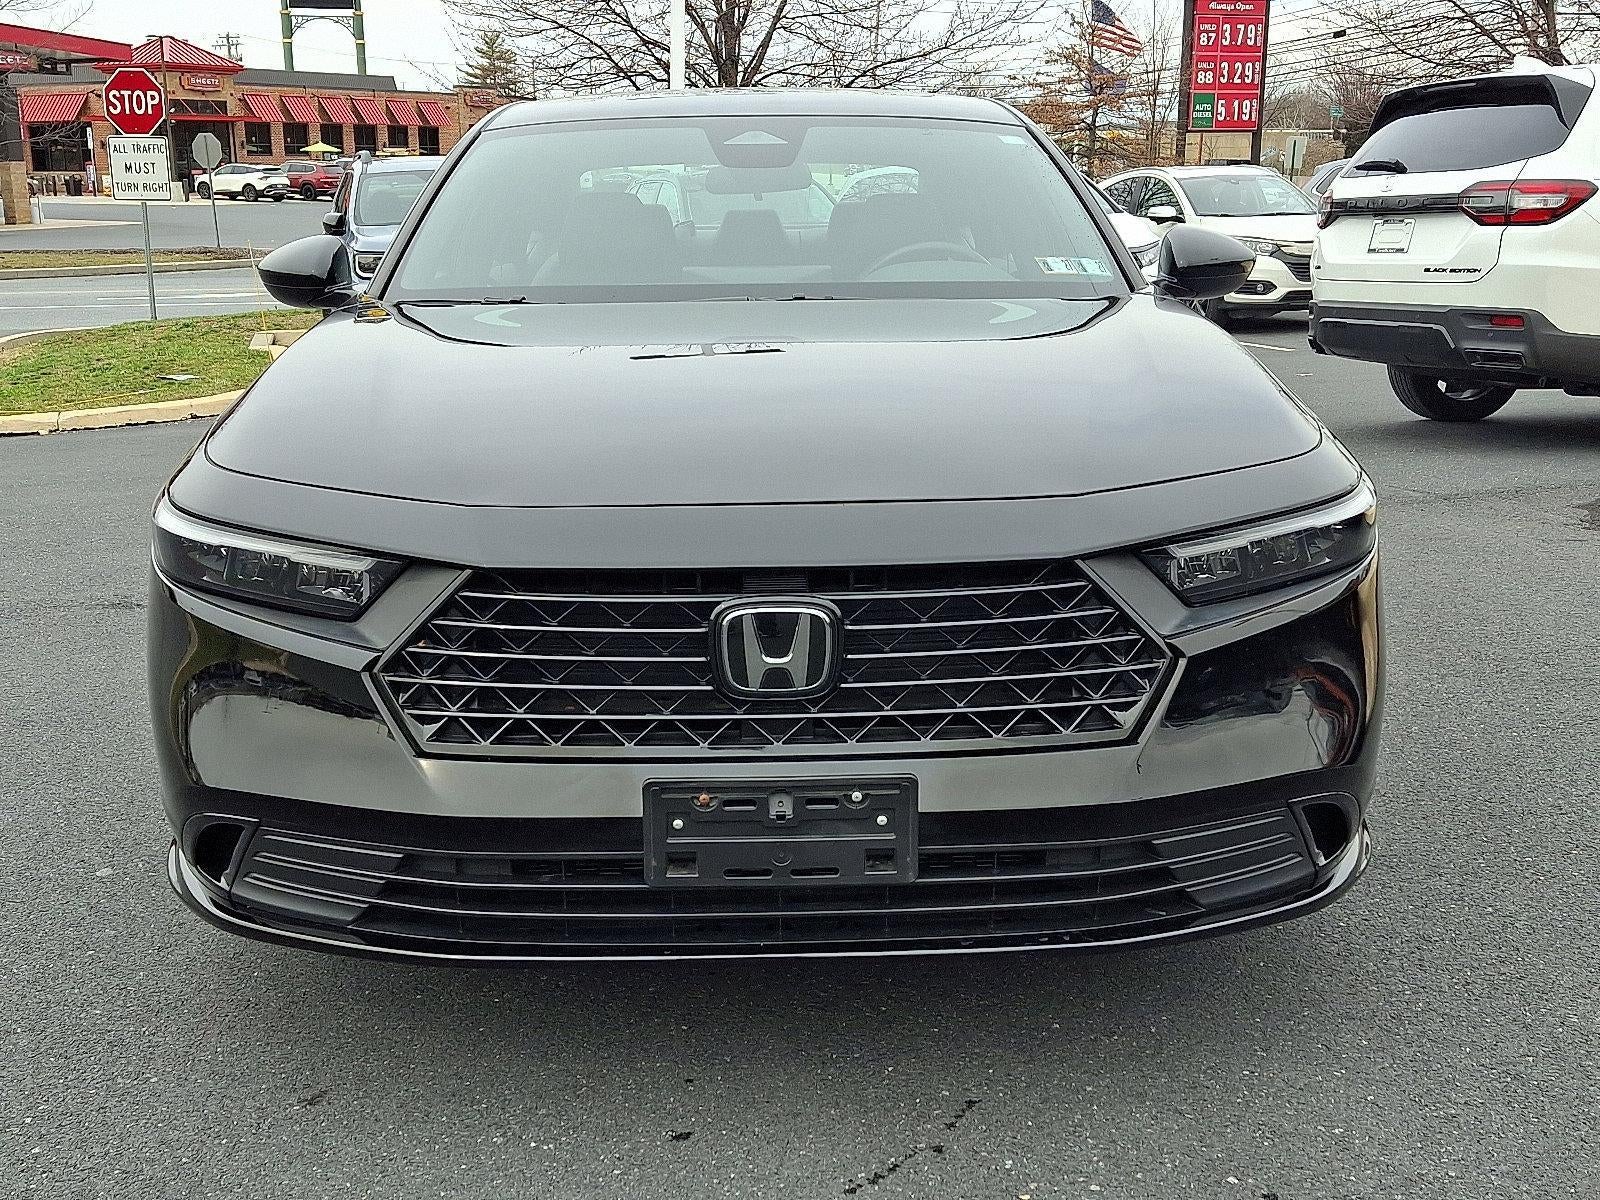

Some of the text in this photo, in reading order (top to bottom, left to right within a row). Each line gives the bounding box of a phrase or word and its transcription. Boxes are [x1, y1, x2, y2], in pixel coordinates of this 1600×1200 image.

[1208, 1, 1254, 11] Always Open
[1200, 23, 1217, 31] UNLD
[1199, 32, 1216, 46] 87
[1222, 23, 1255, 46] 3.79
[1197, 61, 1215, 69] UNLD
[1196, 70, 1214, 84] 88
[1220, 61, 1253, 84] 3.29
[108, 89, 160, 115] STOP
[1195, 103, 1212, 111] AUTO
[1217, 99, 1251, 121] 5.19
[112, 143, 165, 155] ALL TRAFFIC
[124, 161, 156, 175] MUST
[115, 181, 169, 193] TURN RIGHT
